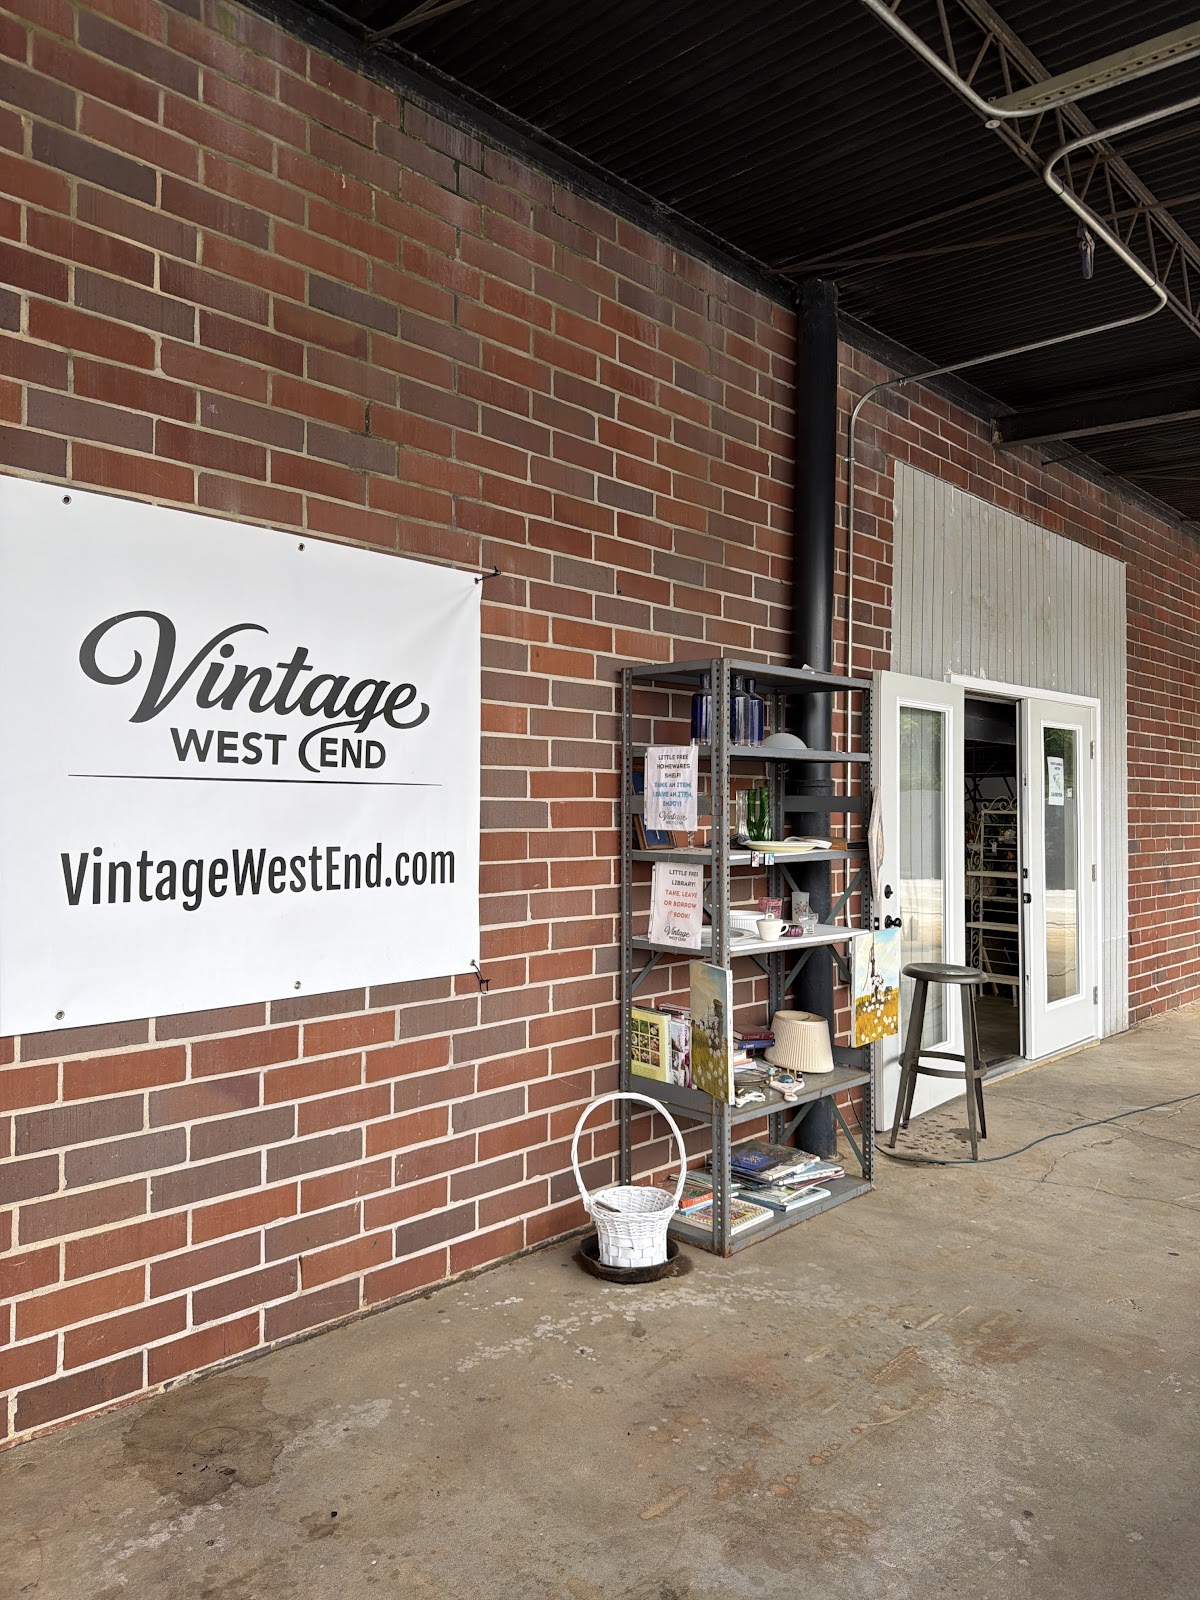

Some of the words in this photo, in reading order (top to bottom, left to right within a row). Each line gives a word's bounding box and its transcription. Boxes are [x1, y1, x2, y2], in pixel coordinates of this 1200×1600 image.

[78, 610, 430, 733] Vintage
[170, 727, 287, 766] WEST
[299, 722, 387, 773] END
[60, 842, 456, 912] VintageWestEnd.com
[665, 889, 681, 897] TAKE,
[673, 901, 697, 909] BORROW
[673, 911, 691, 919] BOOK!
[663, 925, 691, 938] Vintage
